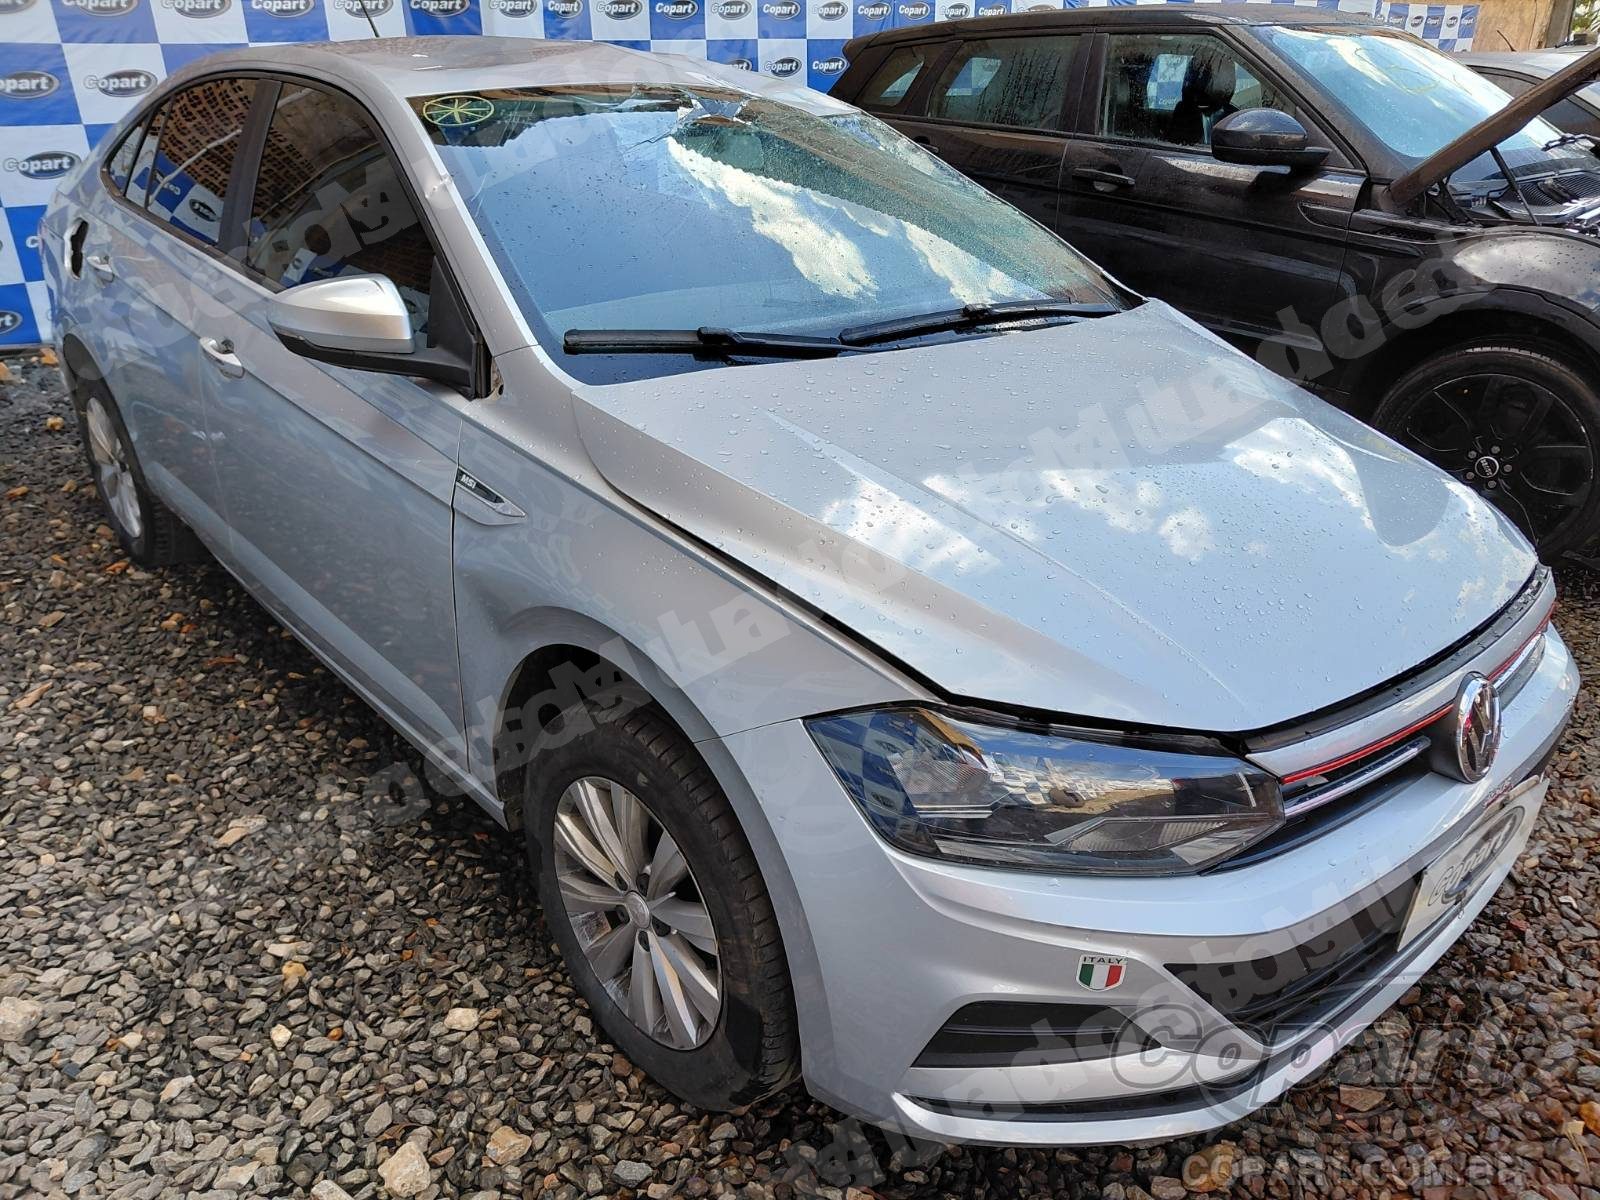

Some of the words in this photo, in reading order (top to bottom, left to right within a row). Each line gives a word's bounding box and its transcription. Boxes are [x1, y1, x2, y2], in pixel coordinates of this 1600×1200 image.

[410, 0, 461, 10] Copart
[490, 0, 532, 10] Copart
[547, 1, 578, 13] Copart
[597, 2, 636, 14] Copart
[655, 2, 693, 14] Copart
[712, 4, 746, 15] Copart
[762, 4, 796, 16] Copart
[812, 6, 843, 16] Copart
[857, 5, 889, 17] Copart
[898, 4, 926, 16] Copart
[941, 6, 967, 17] Copart
[978, 7, 1004, 16] Copart
[764, 60, 797, 73] Copart
[812, 60, 843, 72] Copart
[0, 76, 49, 93] opart
[84, 74, 147, 91] Copart
[3, 156, 71, 174] Copart
[1083, 956, 1123, 965] ITALY
